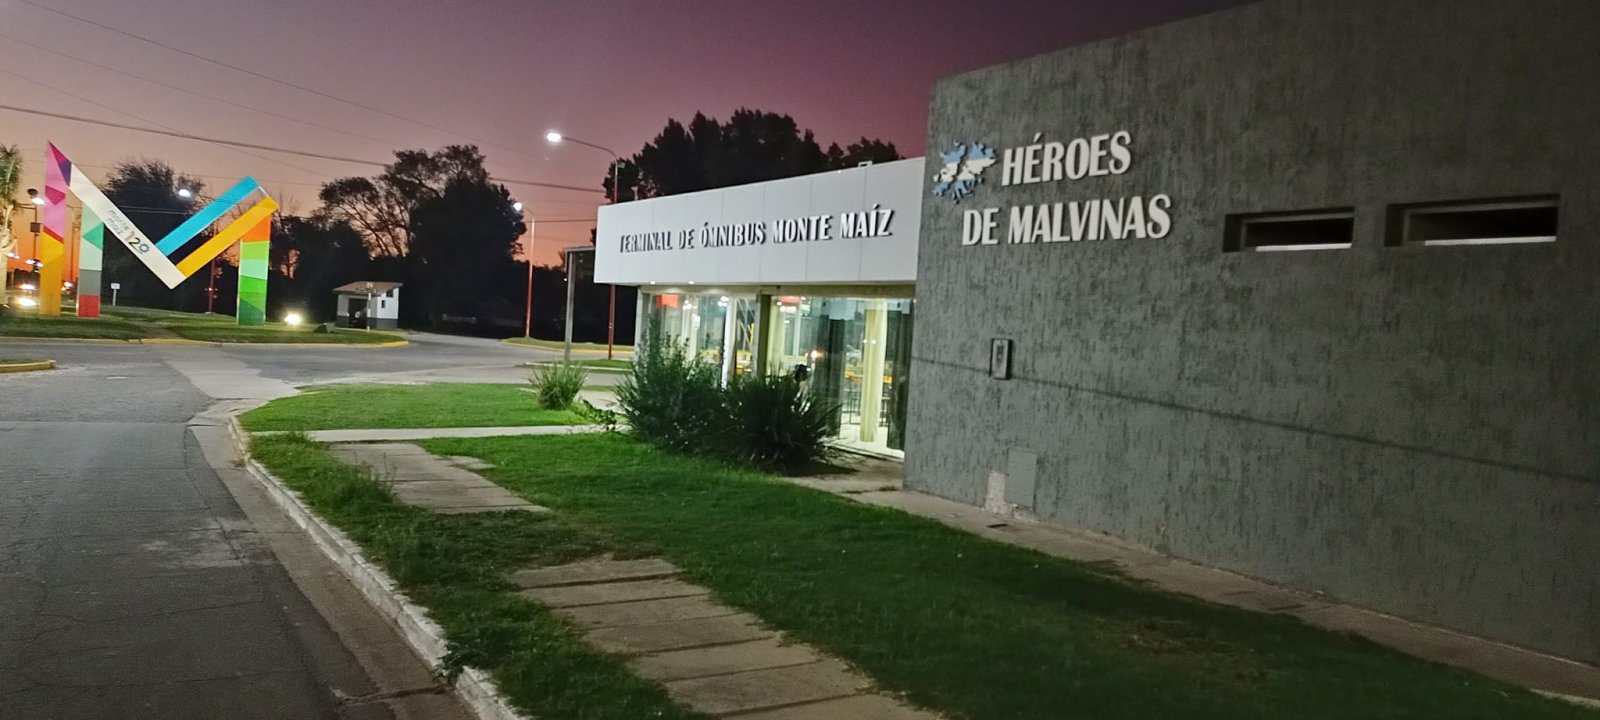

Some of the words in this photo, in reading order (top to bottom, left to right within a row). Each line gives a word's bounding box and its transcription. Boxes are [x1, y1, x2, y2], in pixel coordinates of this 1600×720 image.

[1001, 130, 1131, 186] HÉROES
[619, 231, 673, 253] TERMINAL
[678, 228, 695, 250] DE
[700, 221, 767, 249] ÓMNIBUS
[772, 214, 834, 244] MONTE
[841, 204, 894, 239] MAÍZ
[962, 207, 1000, 246] DE
[1008, 194, 1172, 245] MALVINAS
